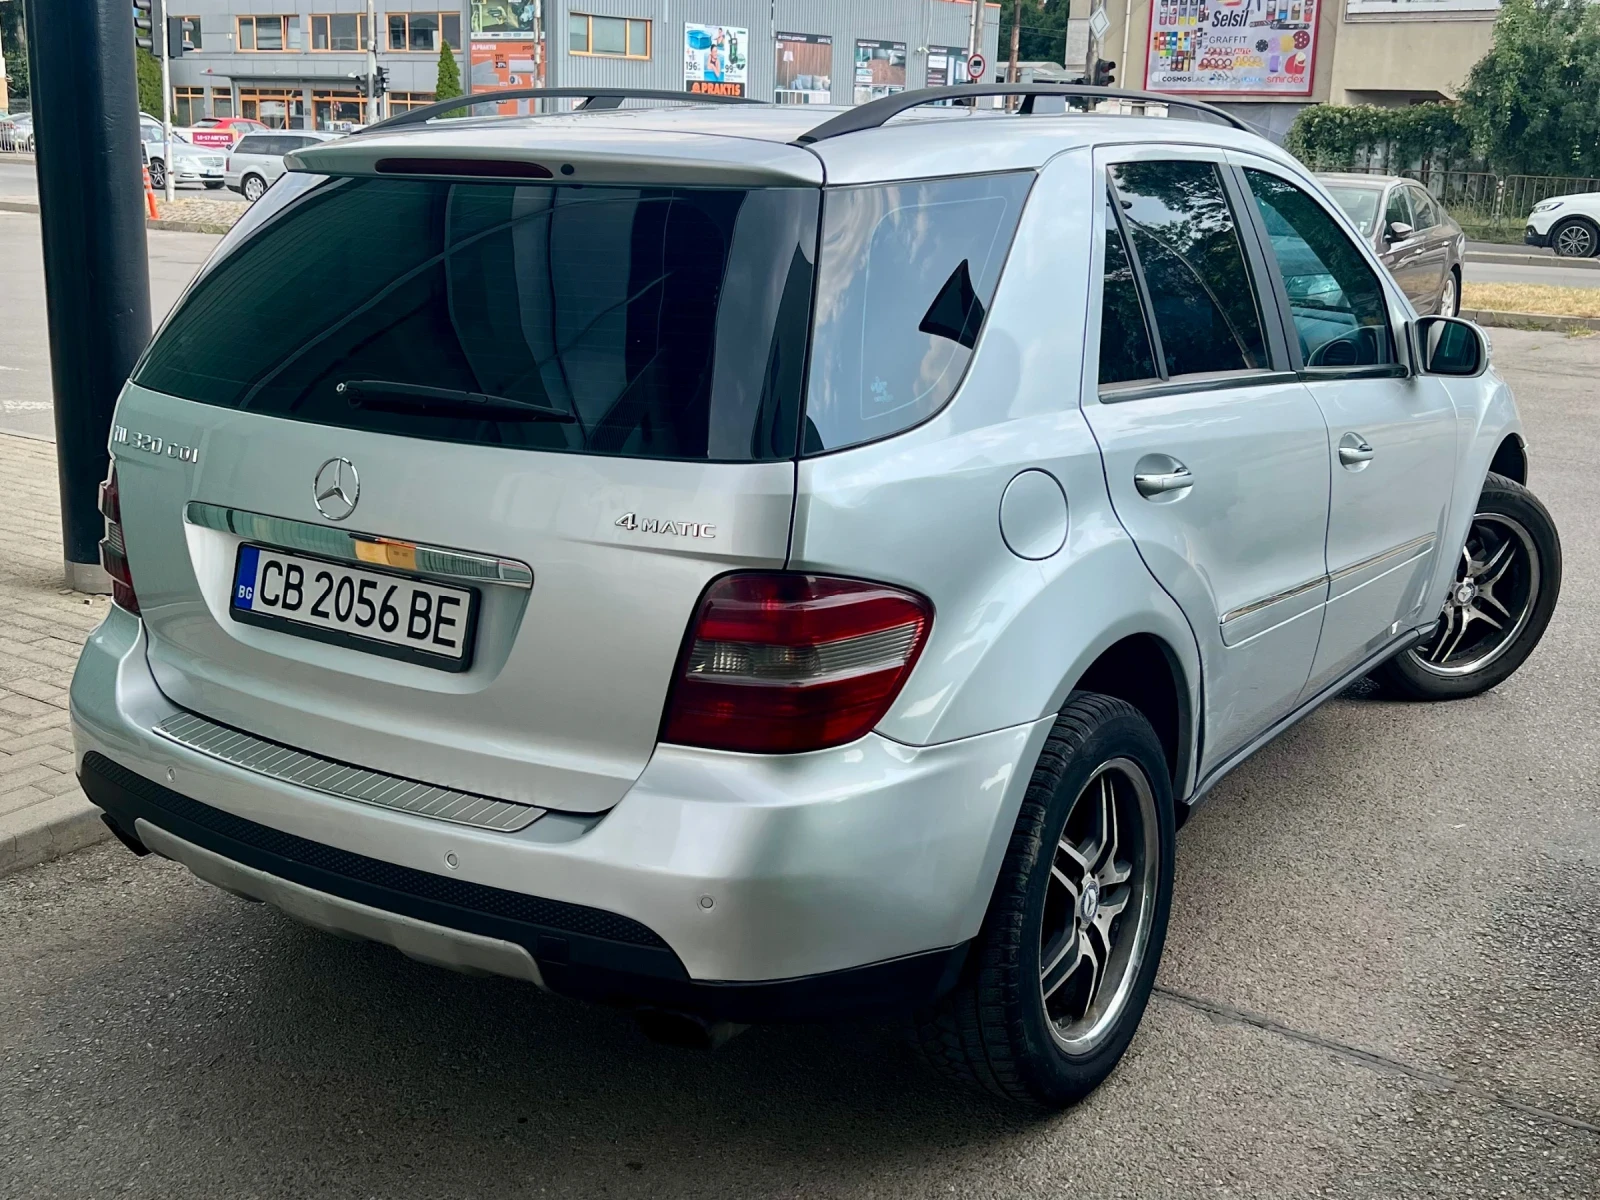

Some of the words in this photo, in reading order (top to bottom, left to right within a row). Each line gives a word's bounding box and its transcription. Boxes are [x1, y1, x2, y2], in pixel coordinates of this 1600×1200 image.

[1212, 10, 1249, 28] Selsil
[1209, 36, 1247, 44] GRAFFIT
[686, 62, 697, 71] 196
[1266, 74, 1306, 84] smirdex
[701, 83, 741, 96] PRAKTIS
[114, 425, 130, 446] ML
[132, 432, 163, 455] 320
[167, 443, 198, 463] CDI
[238, 584, 253, 600] BG
[260, 560, 304, 611] CB
[310, 571, 399, 633] 2056
[407, 589, 461, 648] BE
